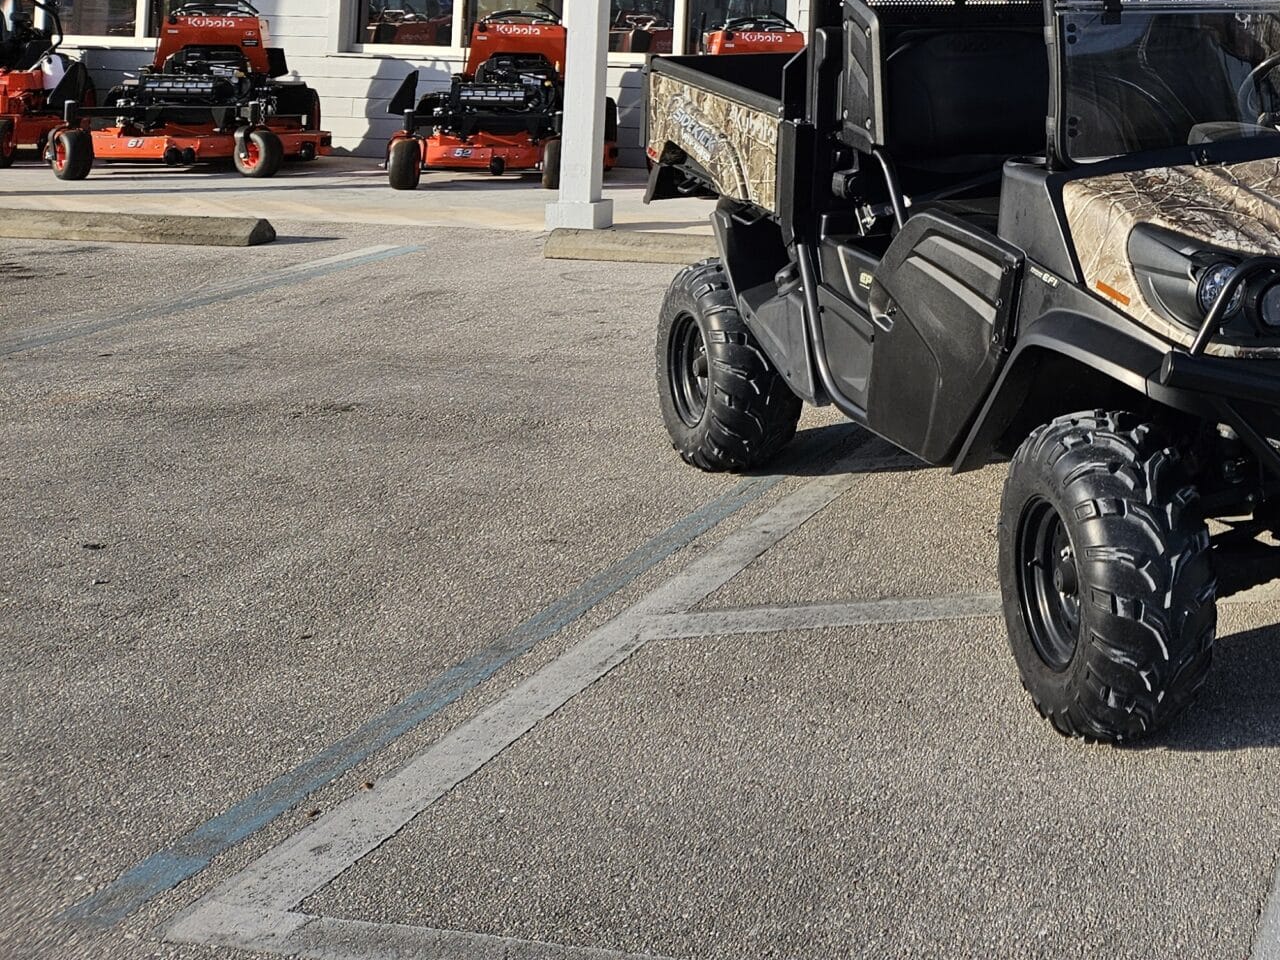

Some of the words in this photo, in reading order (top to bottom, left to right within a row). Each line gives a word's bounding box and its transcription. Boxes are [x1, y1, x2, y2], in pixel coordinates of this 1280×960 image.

[188, 17, 235, 28] Kubota
[496, 24, 540, 35] Kubota
[741, 32, 783, 43] Kubota
[672, 107, 718, 152] SIDEKICK
[1042, 272, 1058, 287] EFI
